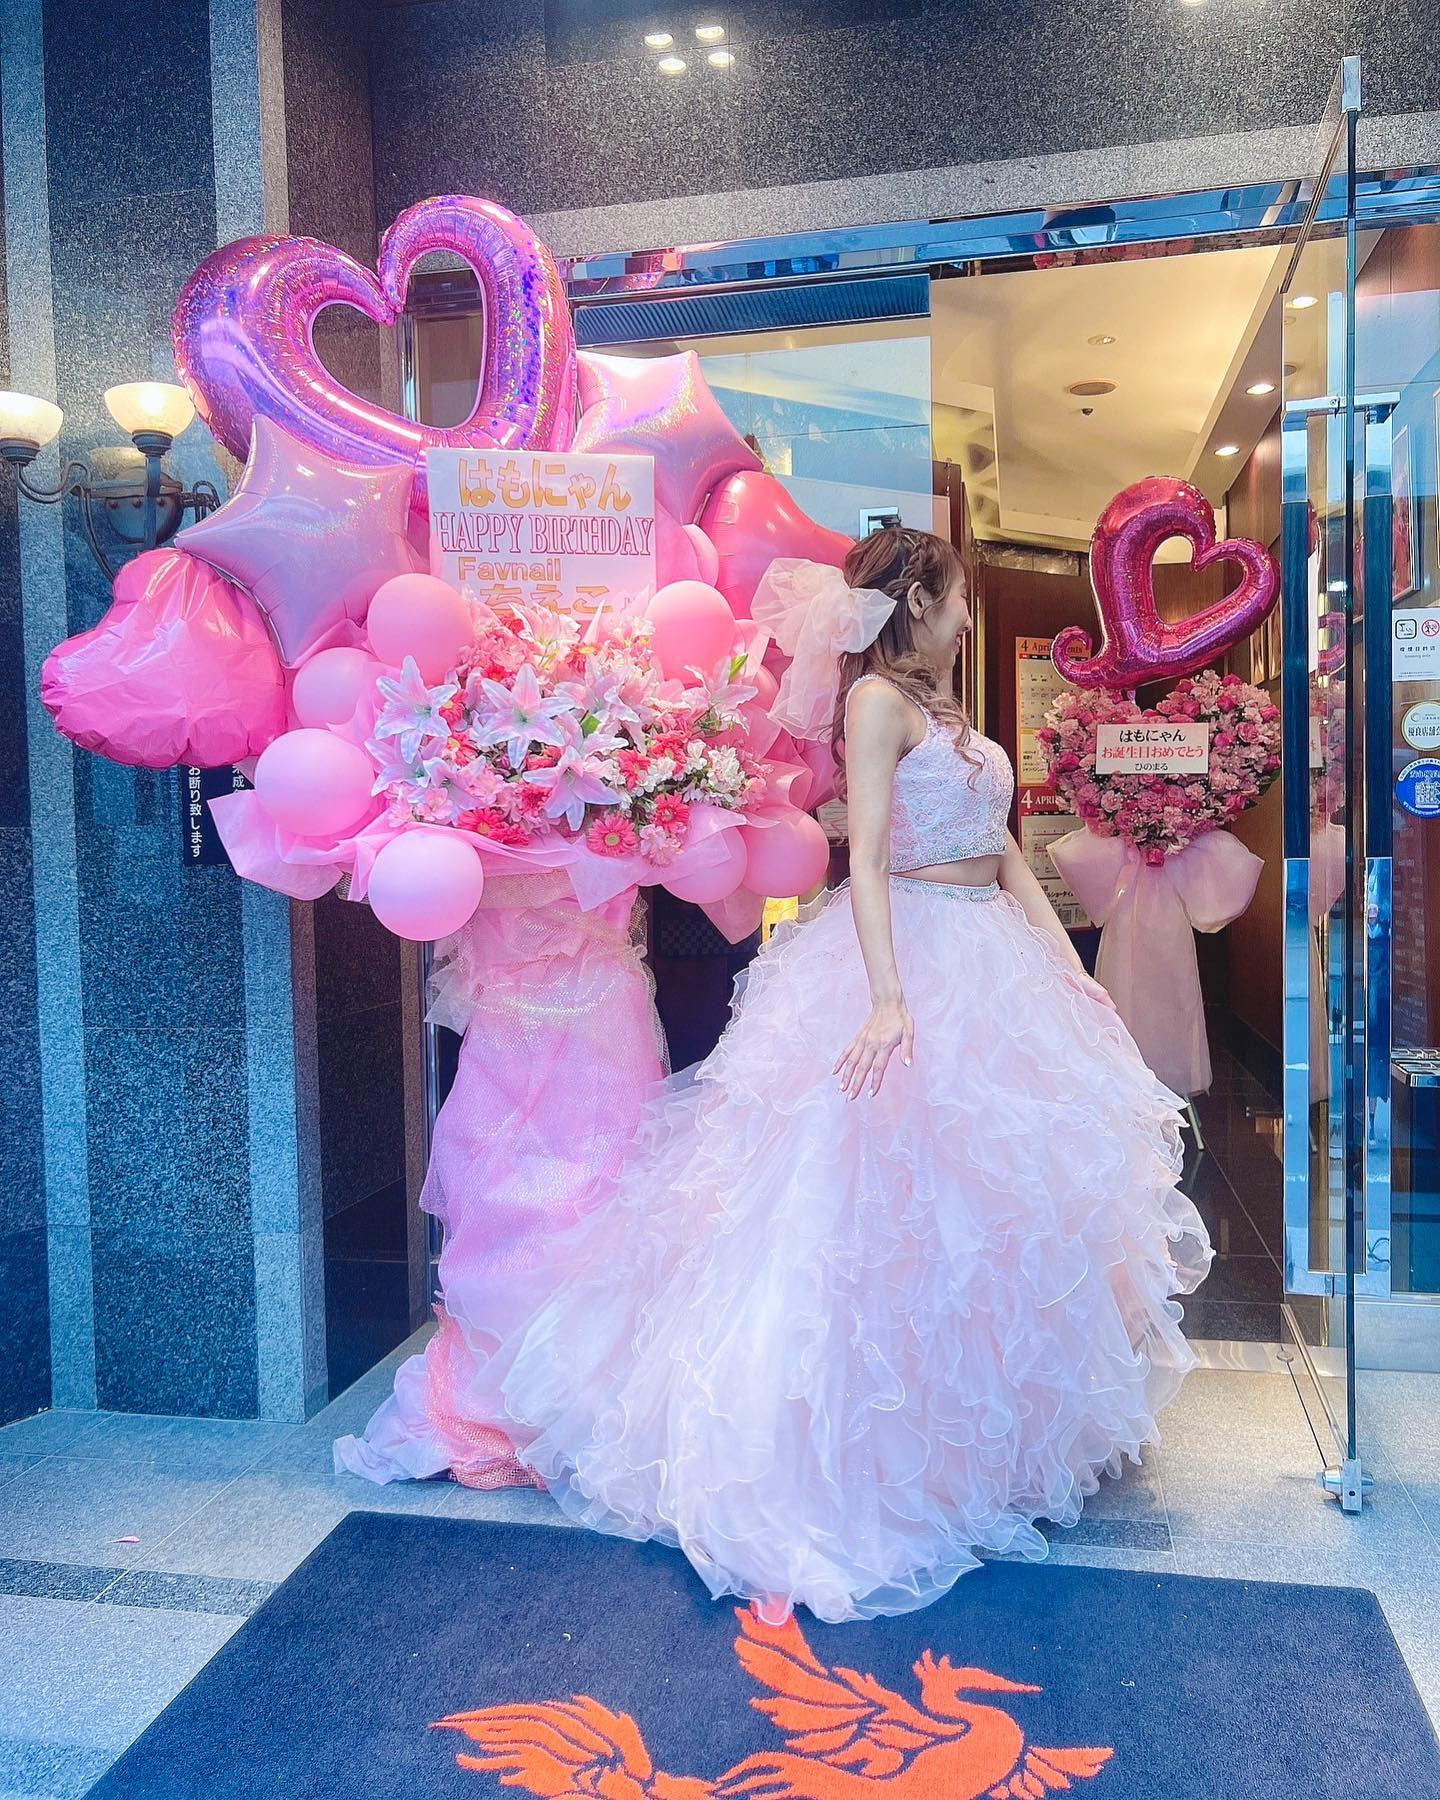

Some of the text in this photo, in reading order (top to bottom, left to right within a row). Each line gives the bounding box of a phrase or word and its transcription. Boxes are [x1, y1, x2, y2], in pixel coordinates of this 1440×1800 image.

[458, 458, 631, 512] はもにゃん
[433, 512, 655, 556] HAPPY BIRTHDAY
[458, 556, 562, 581] Favnail
[1020, 640, 1029, 652] 4
[1031, 641, 1051, 655] Apri
[1119, 729, 1186, 743] はもにゃん
[1101, 745, 1204, 759] お誕生日おめでとう
[1134, 762, 1168, 771] ひのまる
[1020, 789, 1056, 809] 4 APRI
